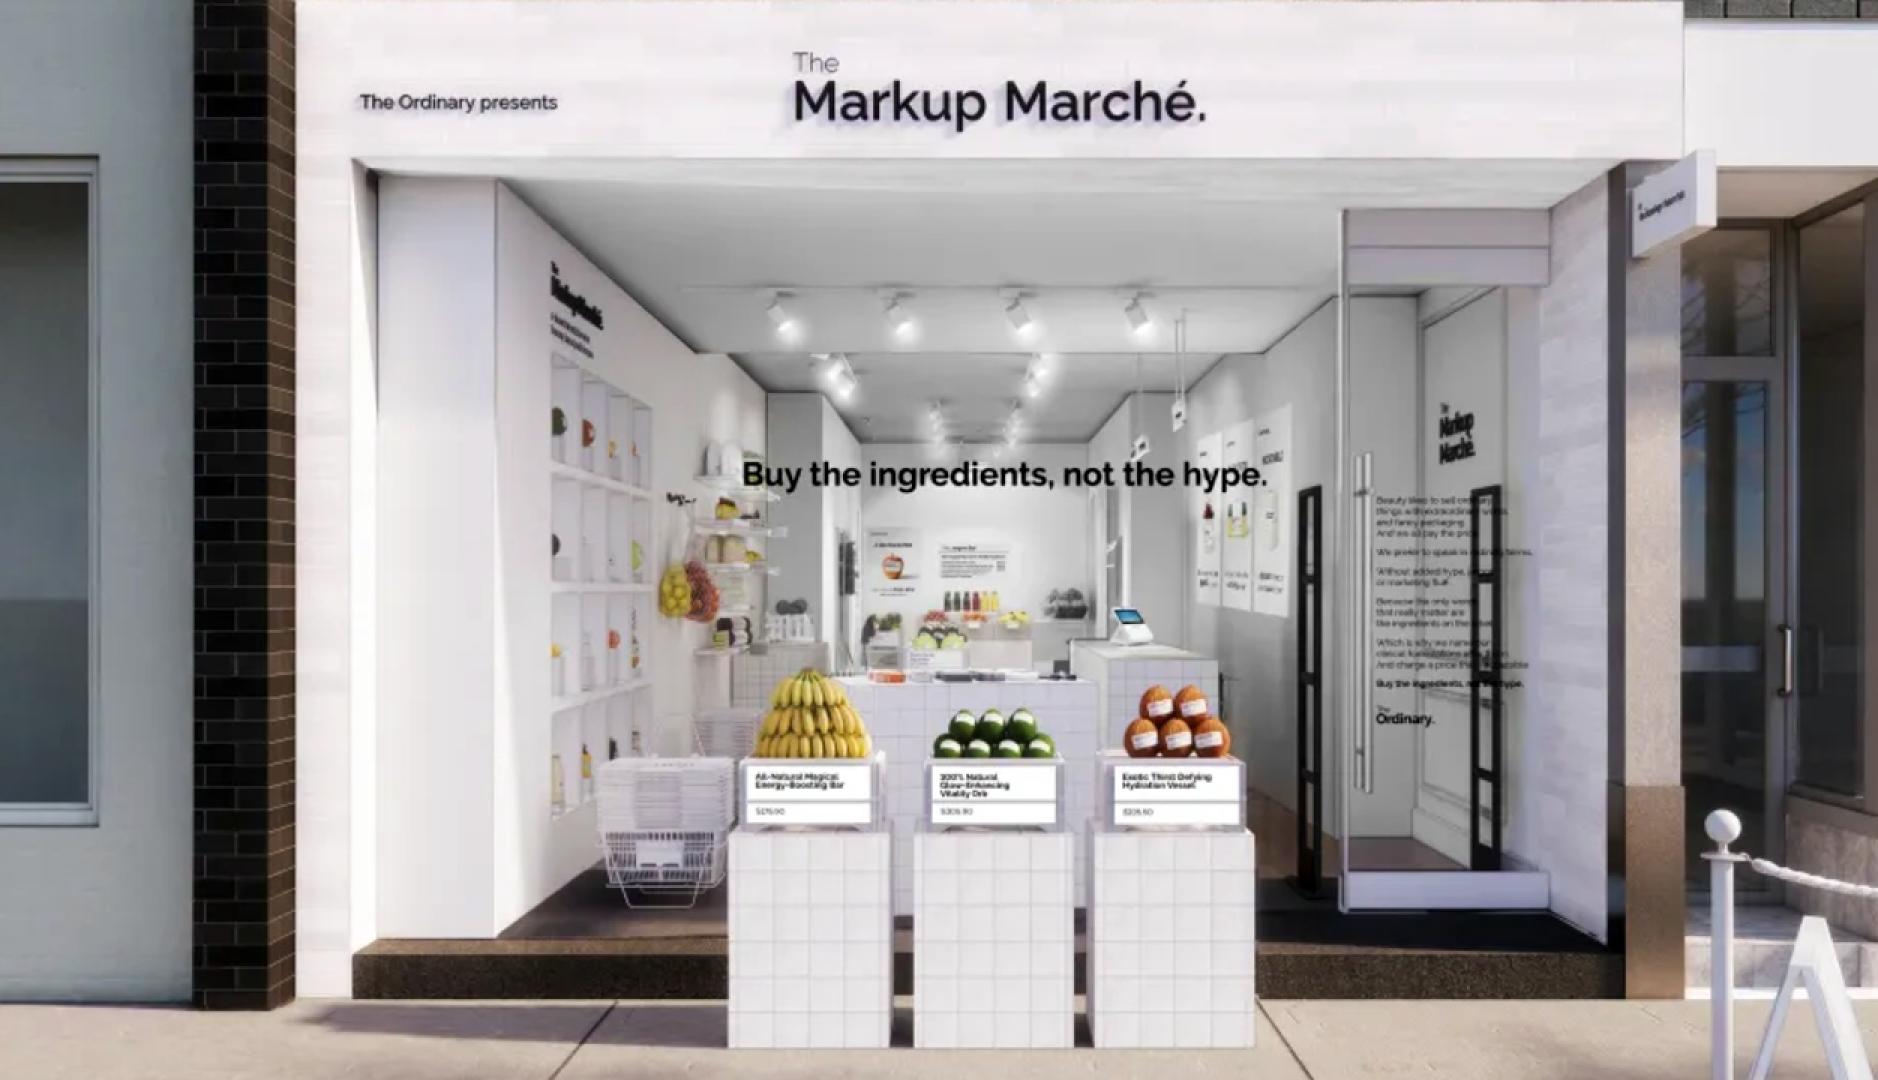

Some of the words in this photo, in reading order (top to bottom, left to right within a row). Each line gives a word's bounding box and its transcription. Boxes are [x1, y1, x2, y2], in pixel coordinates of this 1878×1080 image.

[793, 51, 840, 74] The
[359, 94, 394, 110] The
[398, 94, 475, 113] Ordinary
[480, 95, 558, 113] presents
[795, 80, 987, 133] Markup
[1006, 80, 1206, 123] Marché.
[743, 461, 802, 494] Buy
[809, 461, 862, 488] the
[870, 461, 1054, 494] ingredients,
[1064, 462, 1115, 488] not
[1123, 461, 1174, 488] the
[1184, 461, 1268, 494] hype.
[1376, 713, 1436, 728] Ordinary.
